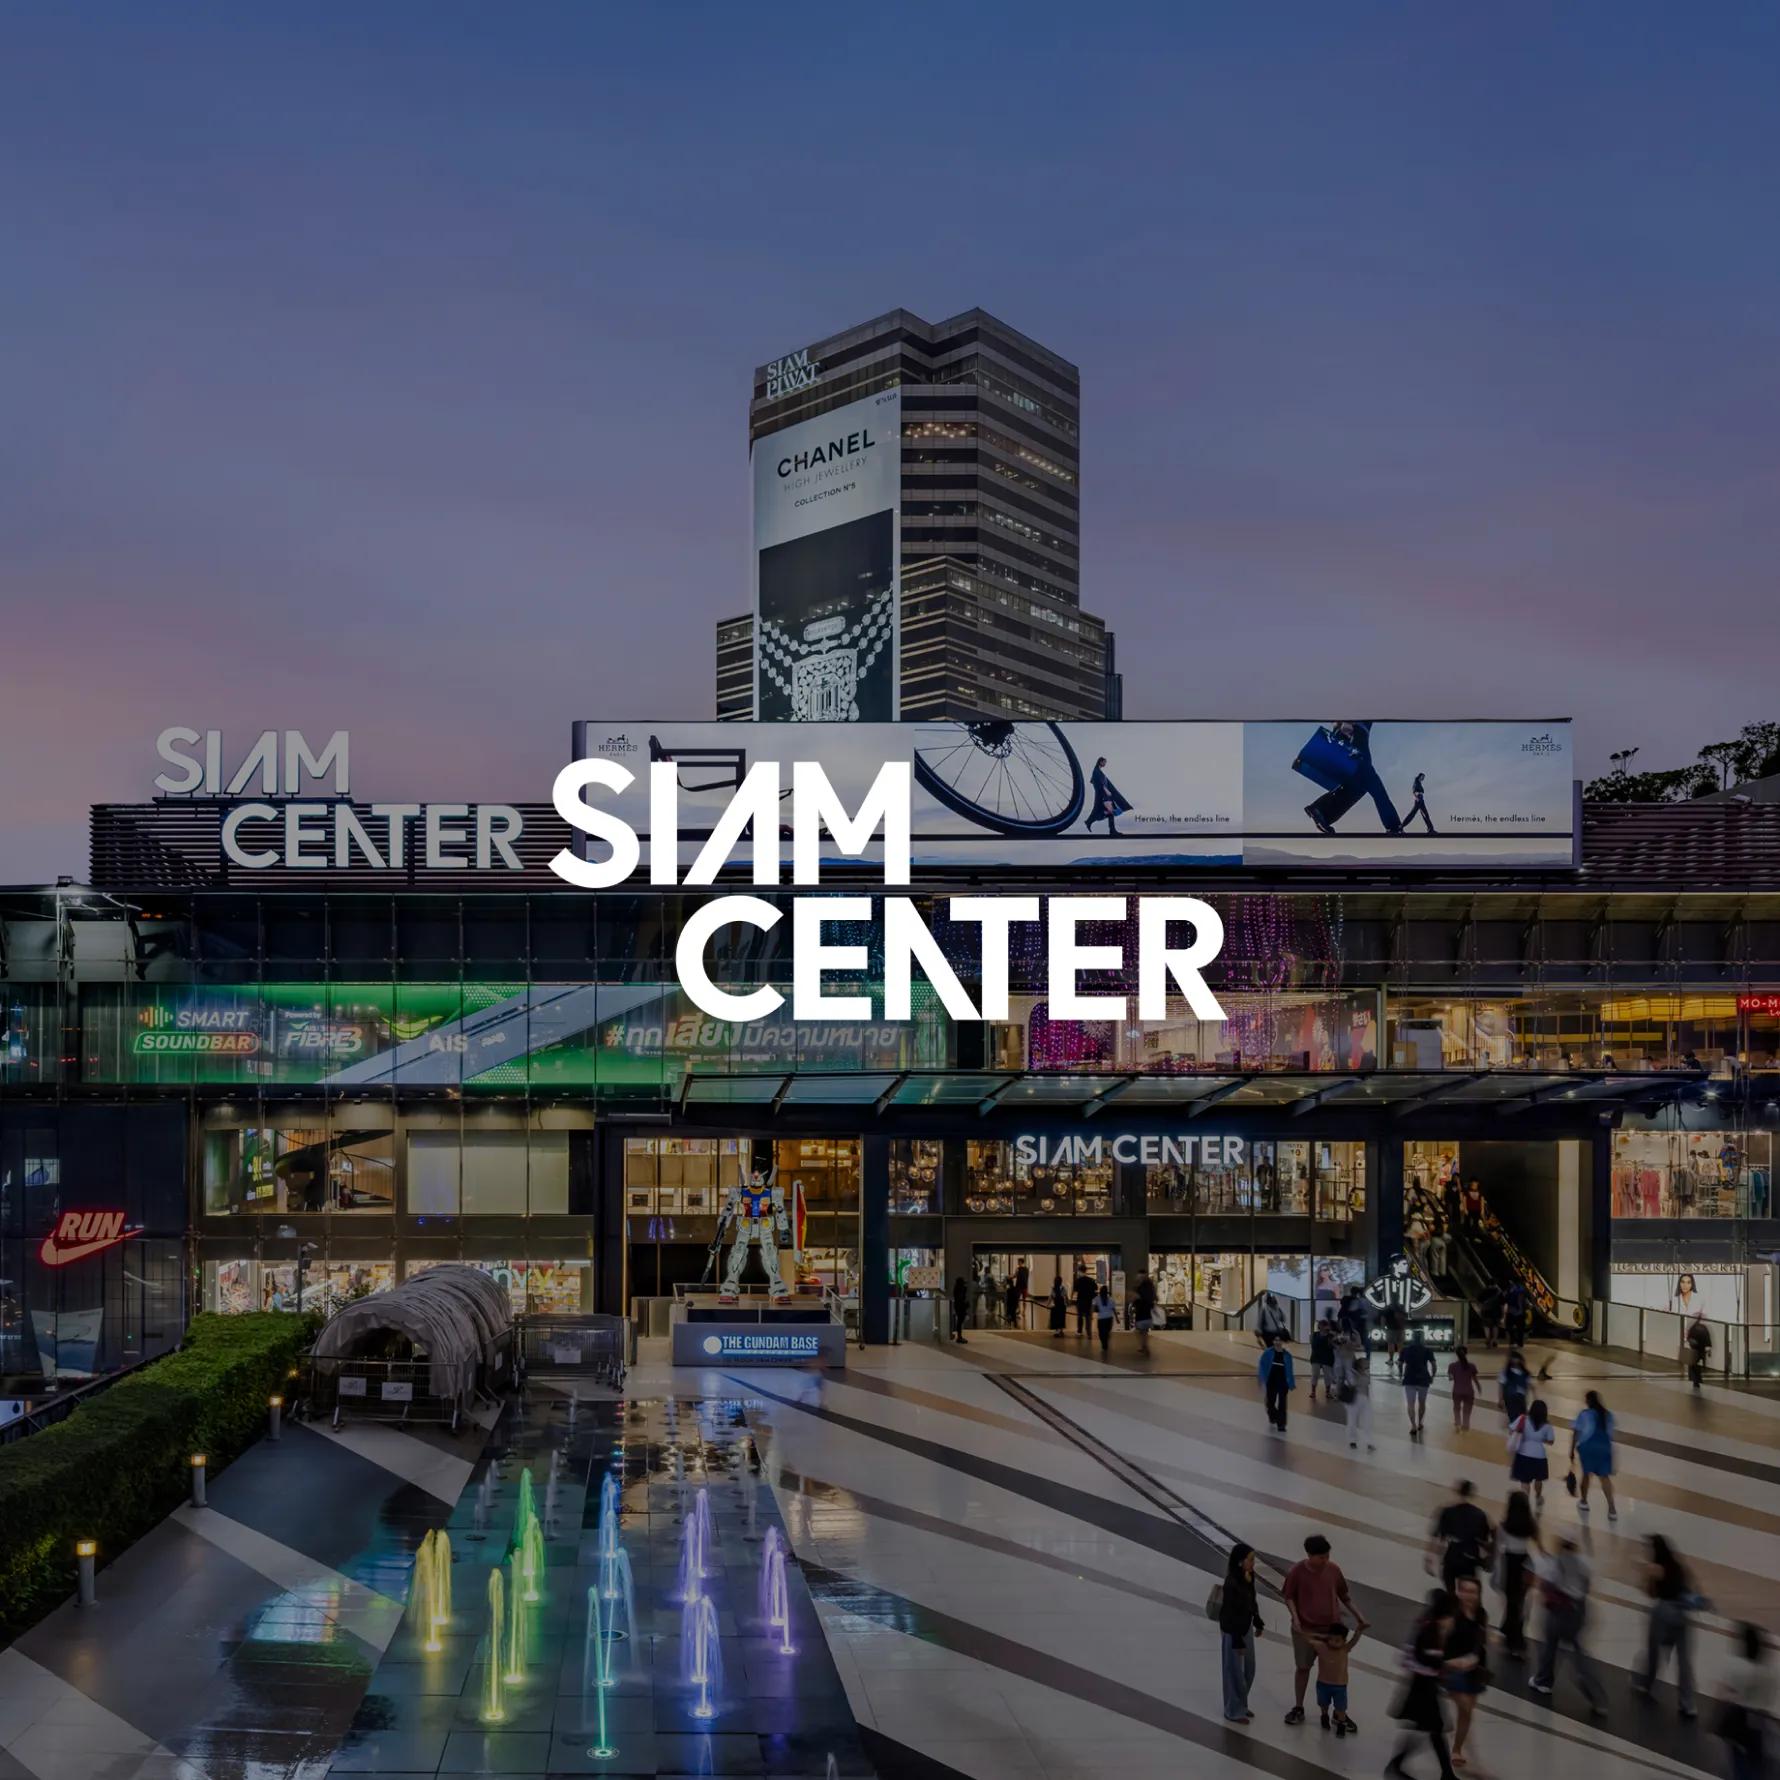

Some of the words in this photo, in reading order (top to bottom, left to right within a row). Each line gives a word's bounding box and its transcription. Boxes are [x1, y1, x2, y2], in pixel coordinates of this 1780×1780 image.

[767, 349, 809, 381] SIAM
[766, 362, 821, 401] PIWAT
[777, 429, 875, 478] CHANEL
[784, 476, 810, 494] HIGH
[815, 456, 868, 484] JEWELLERY
[794, 487, 841, 508] COLLECTION
[153, 727, 350, 794] SIAM
[1485, 814, 1498, 822] the
[1500, 814, 1529, 822] endless
[1530, 814, 1546, 822] line
[221, 803, 524, 869] CENTER
[177, 1011, 249, 1028] SMART
[142, 1036, 249, 1049] SOUNDBAR
[429, 1034, 469, 1052] AIS
[1015, 1134, 1102, 1165] SIAM
[1112, 1134, 1243, 1165] CENTER
[59, 1212, 125, 1240] RUN
[723, 1336, 742, 1349] THE
[791, 1337, 818, 1350] BASE
